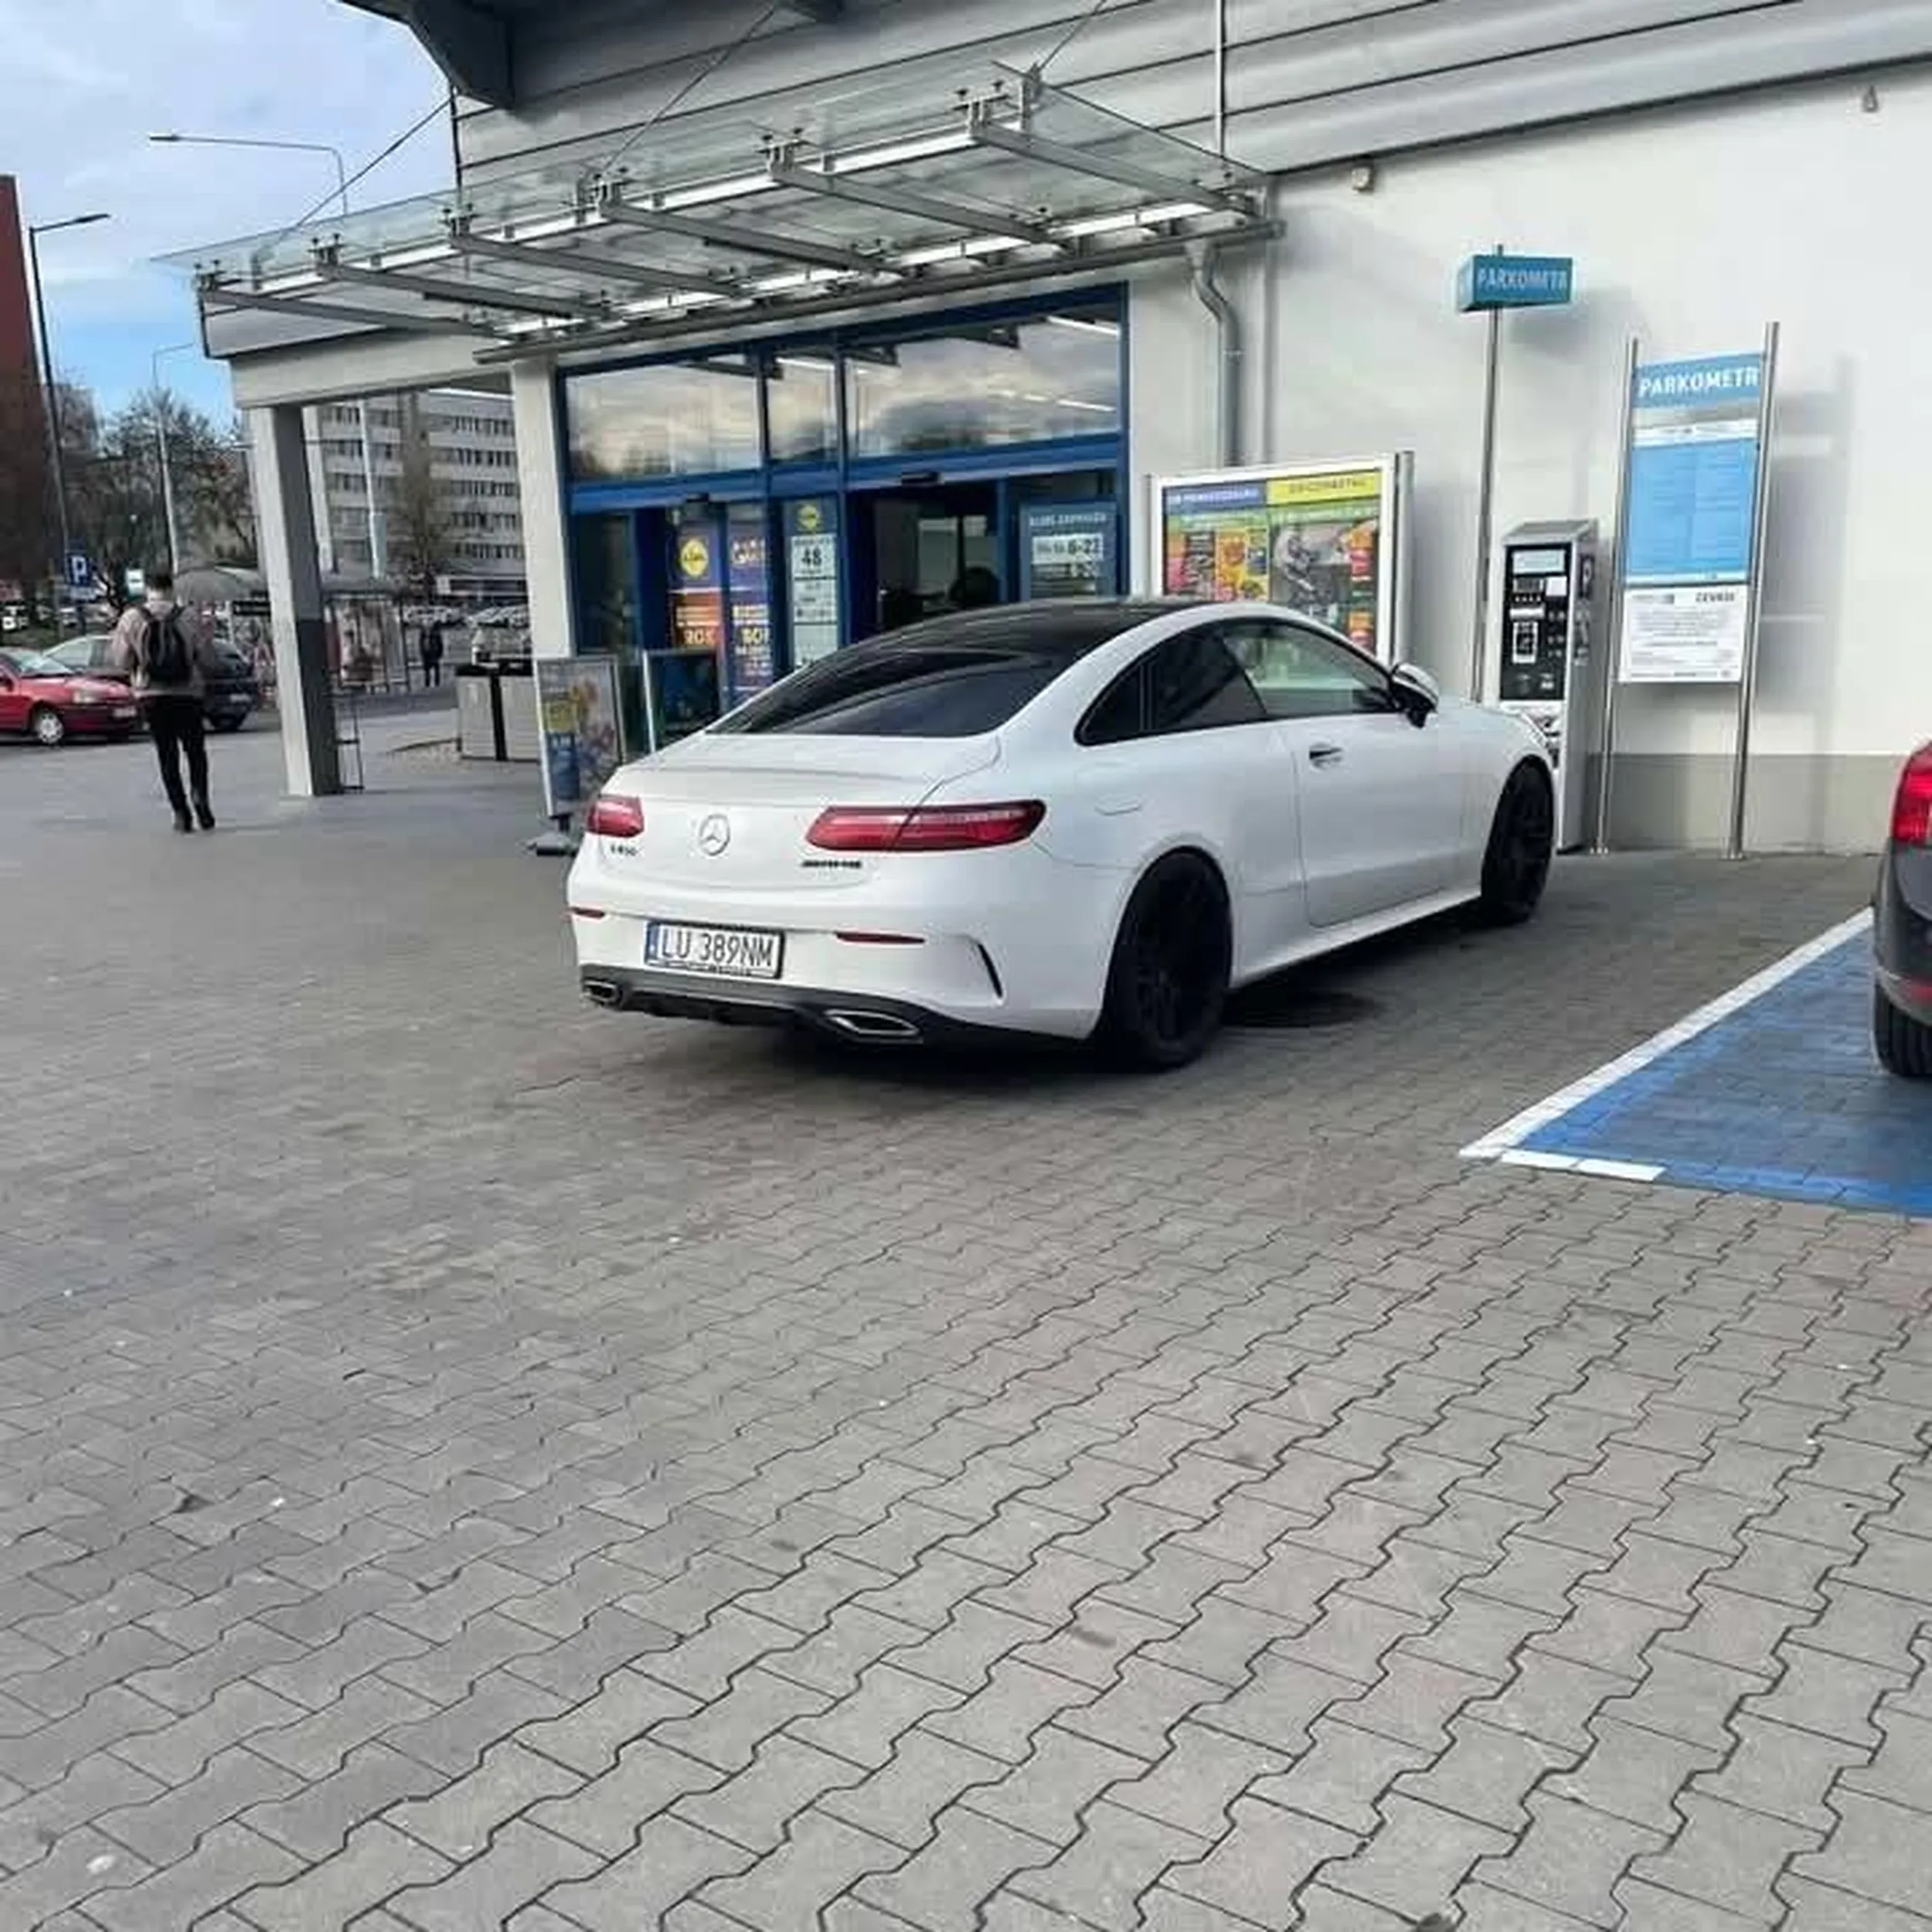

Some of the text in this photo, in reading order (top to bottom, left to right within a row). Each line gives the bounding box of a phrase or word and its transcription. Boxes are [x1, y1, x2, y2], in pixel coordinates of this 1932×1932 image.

[1477, 267, 1568, 291] PARKOMETR
[1638, 366, 1760, 399] PARKOMETR
[72, 556, 87, 583] P
[662, 928, 773, 967] LU 389NM
